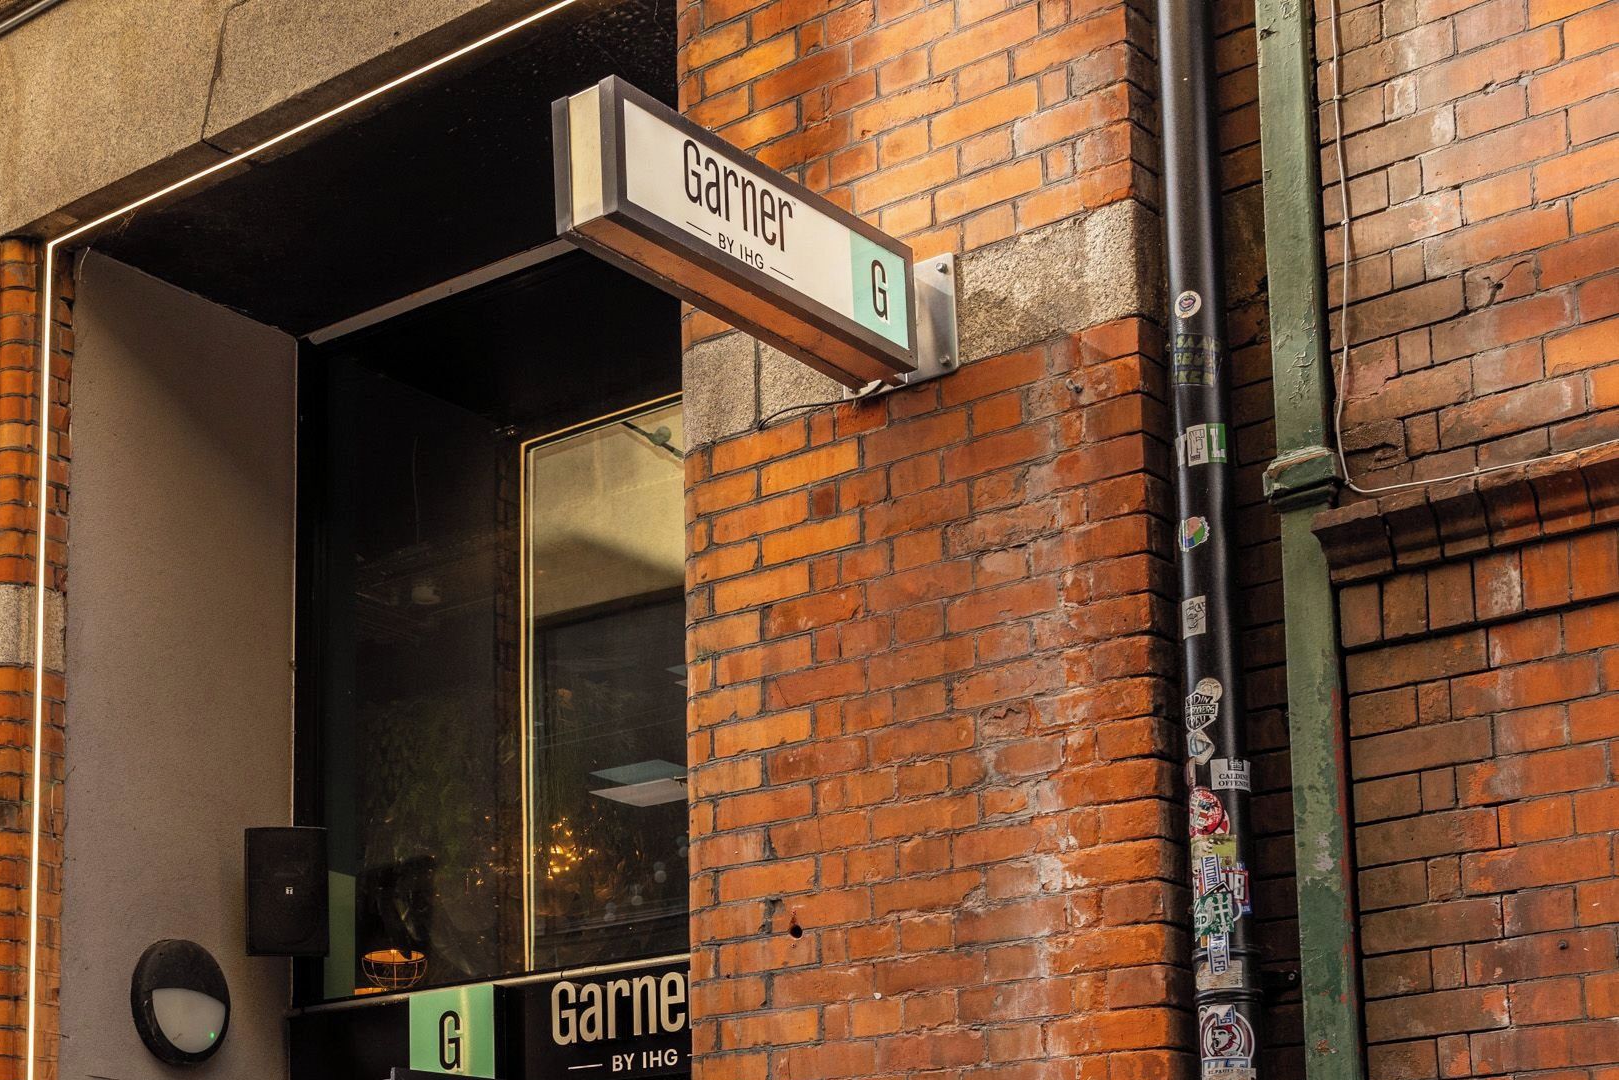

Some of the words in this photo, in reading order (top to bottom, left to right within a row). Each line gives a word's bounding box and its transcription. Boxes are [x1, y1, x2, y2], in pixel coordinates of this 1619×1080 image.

[683, 138, 793, 253] Garner
[718, 232, 735, 256] BY
[739, 244, 765, 271] IHG
[871, 259, 889, 323] G
[551, 970, 692, 1046] Garne
[439, 1010, 462, 1071] G
[612, 1053, 635, 1072] BY
[642, 1048, 678, 1069] IHG
